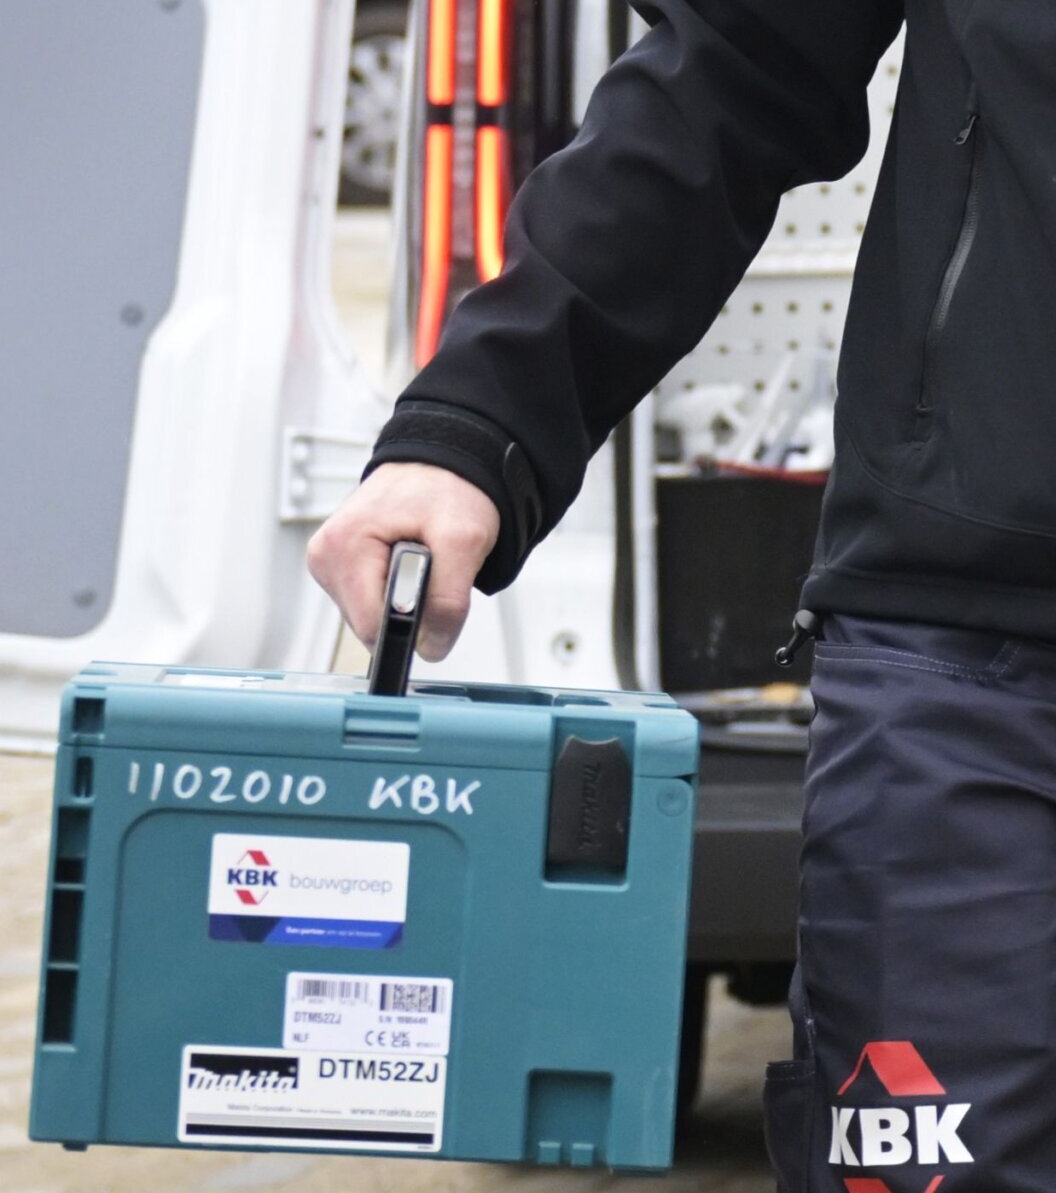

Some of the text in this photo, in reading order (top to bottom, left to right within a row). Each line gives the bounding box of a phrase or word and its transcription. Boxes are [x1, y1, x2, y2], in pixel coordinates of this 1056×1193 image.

[128, 761, 482, 815] 1102010 KBK
[227, 868, 393, 895] KBK bouwgroep
[318, 1058, 439, 1083] DTM52ZJ
[349, 1107, 438, 1118] www.makita.com
[828, 1103, 975, 1167] KBK
